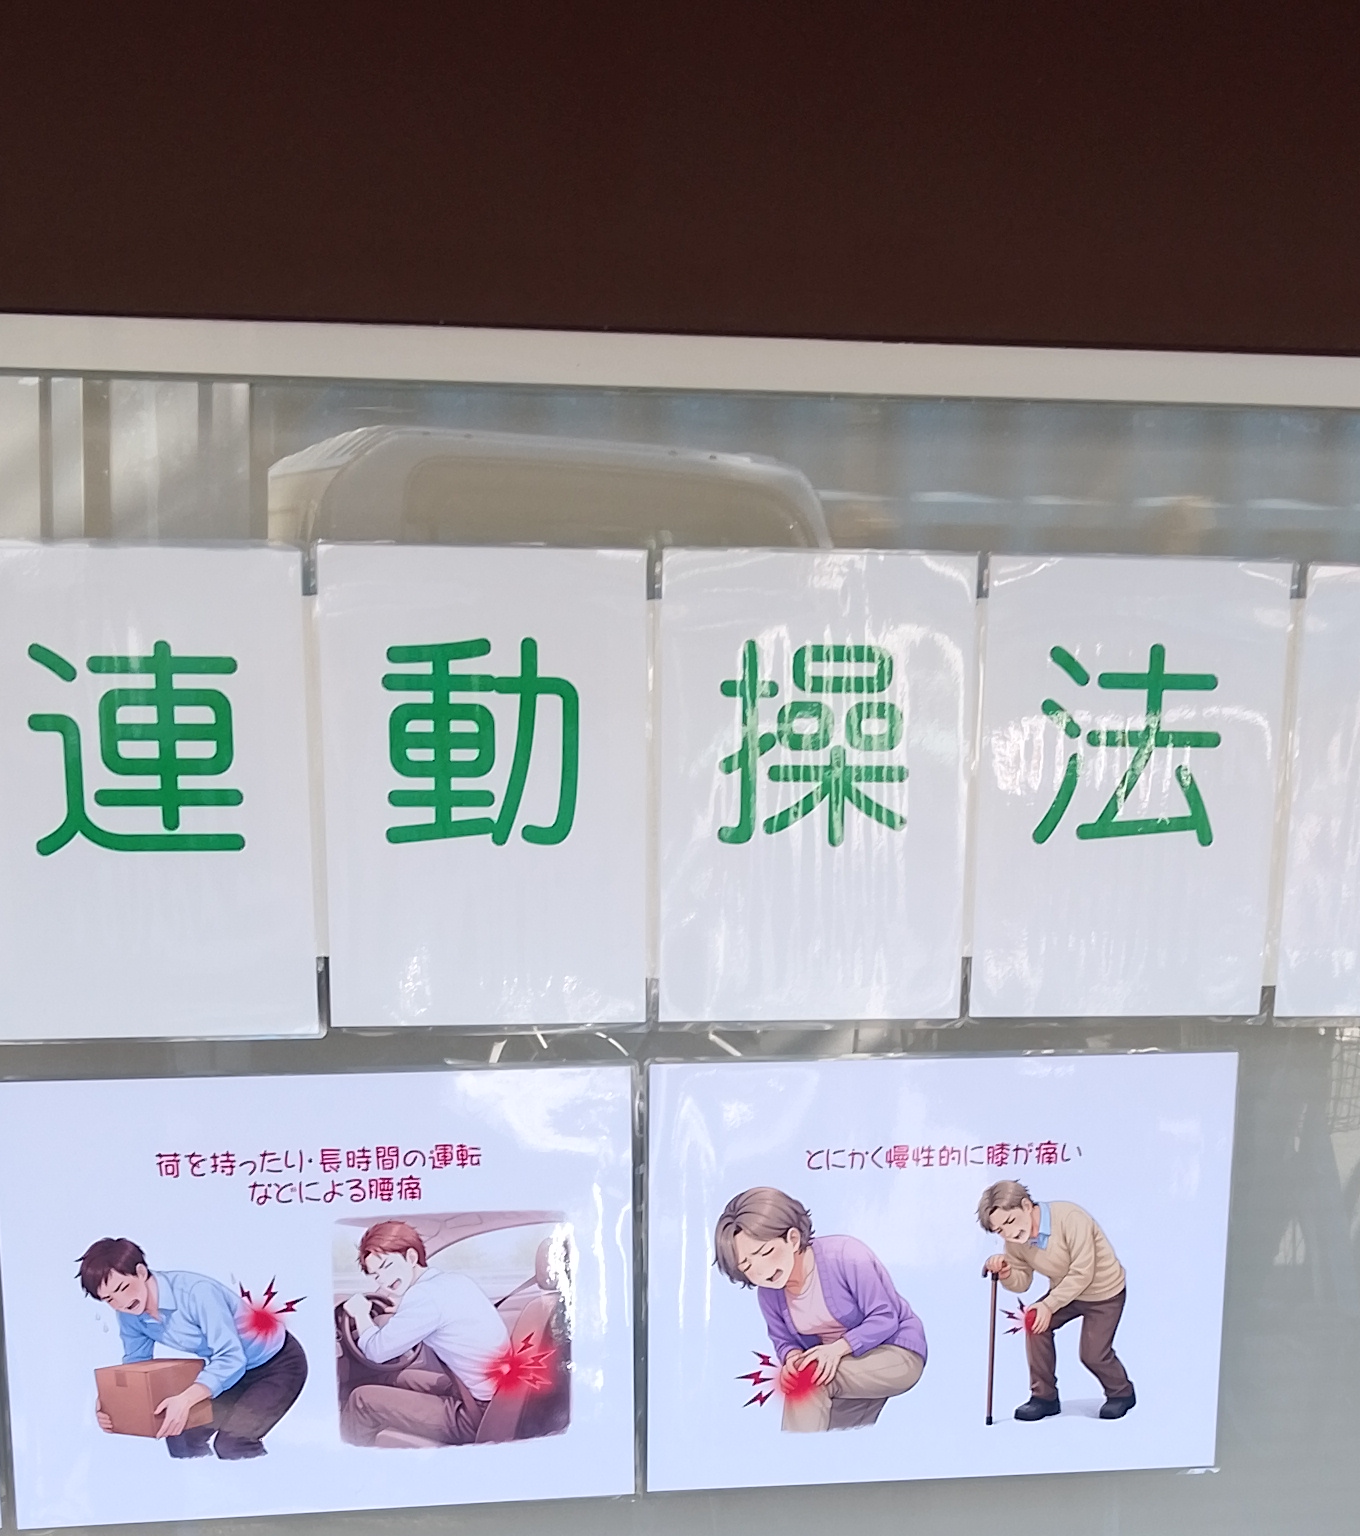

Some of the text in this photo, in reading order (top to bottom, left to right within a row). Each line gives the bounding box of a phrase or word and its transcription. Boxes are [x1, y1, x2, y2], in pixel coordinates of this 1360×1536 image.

[805, 1140, 1084, 1172] とにかく慢性的に膝が痛い
[247, 1174, 423, 1206] などによる腰痛
